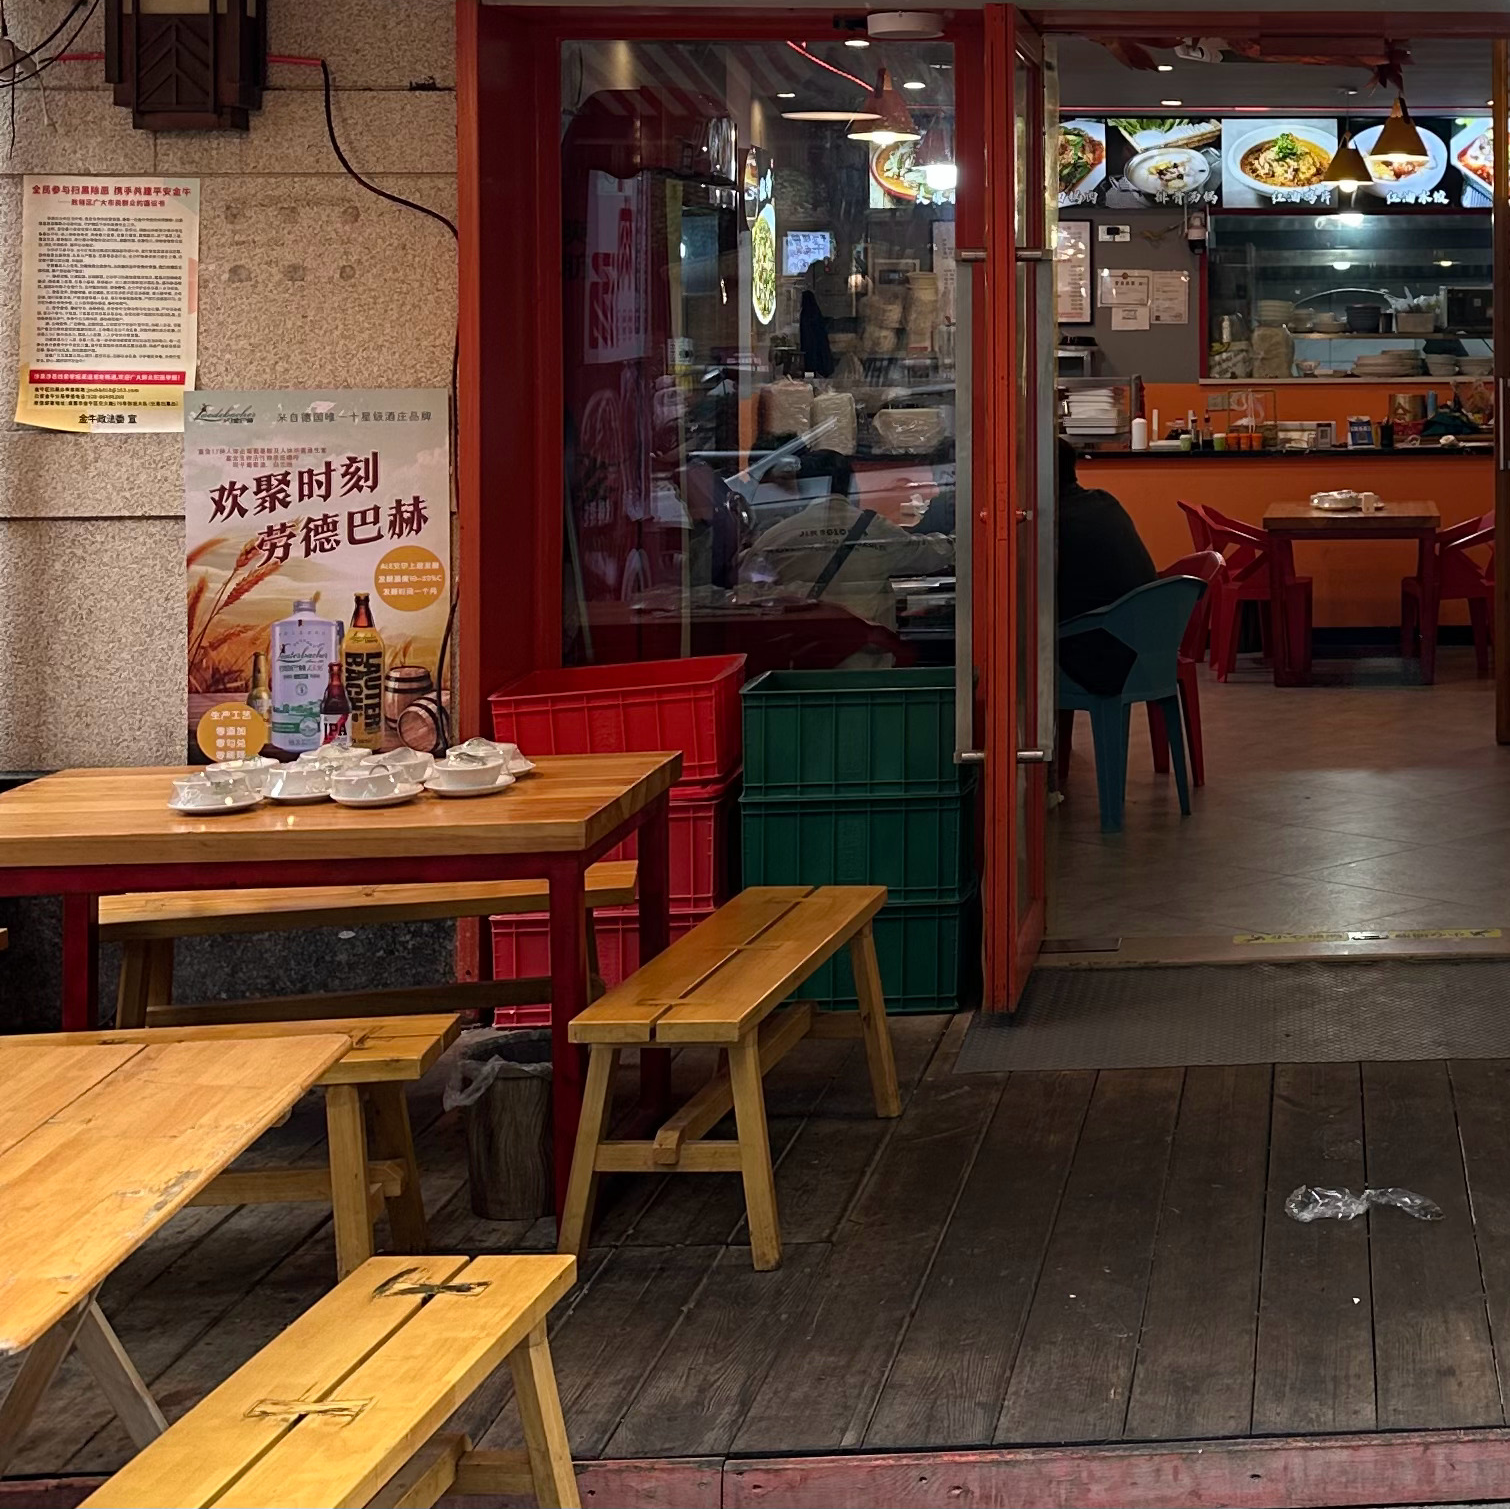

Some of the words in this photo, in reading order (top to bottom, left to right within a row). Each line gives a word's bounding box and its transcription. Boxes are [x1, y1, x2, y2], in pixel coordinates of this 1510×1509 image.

[208, 451, 380, 524] 欢聚时刻
[256, 495, 430, 568] 劳德巴赫
[210, 710, 252, 720] 生产工艺
